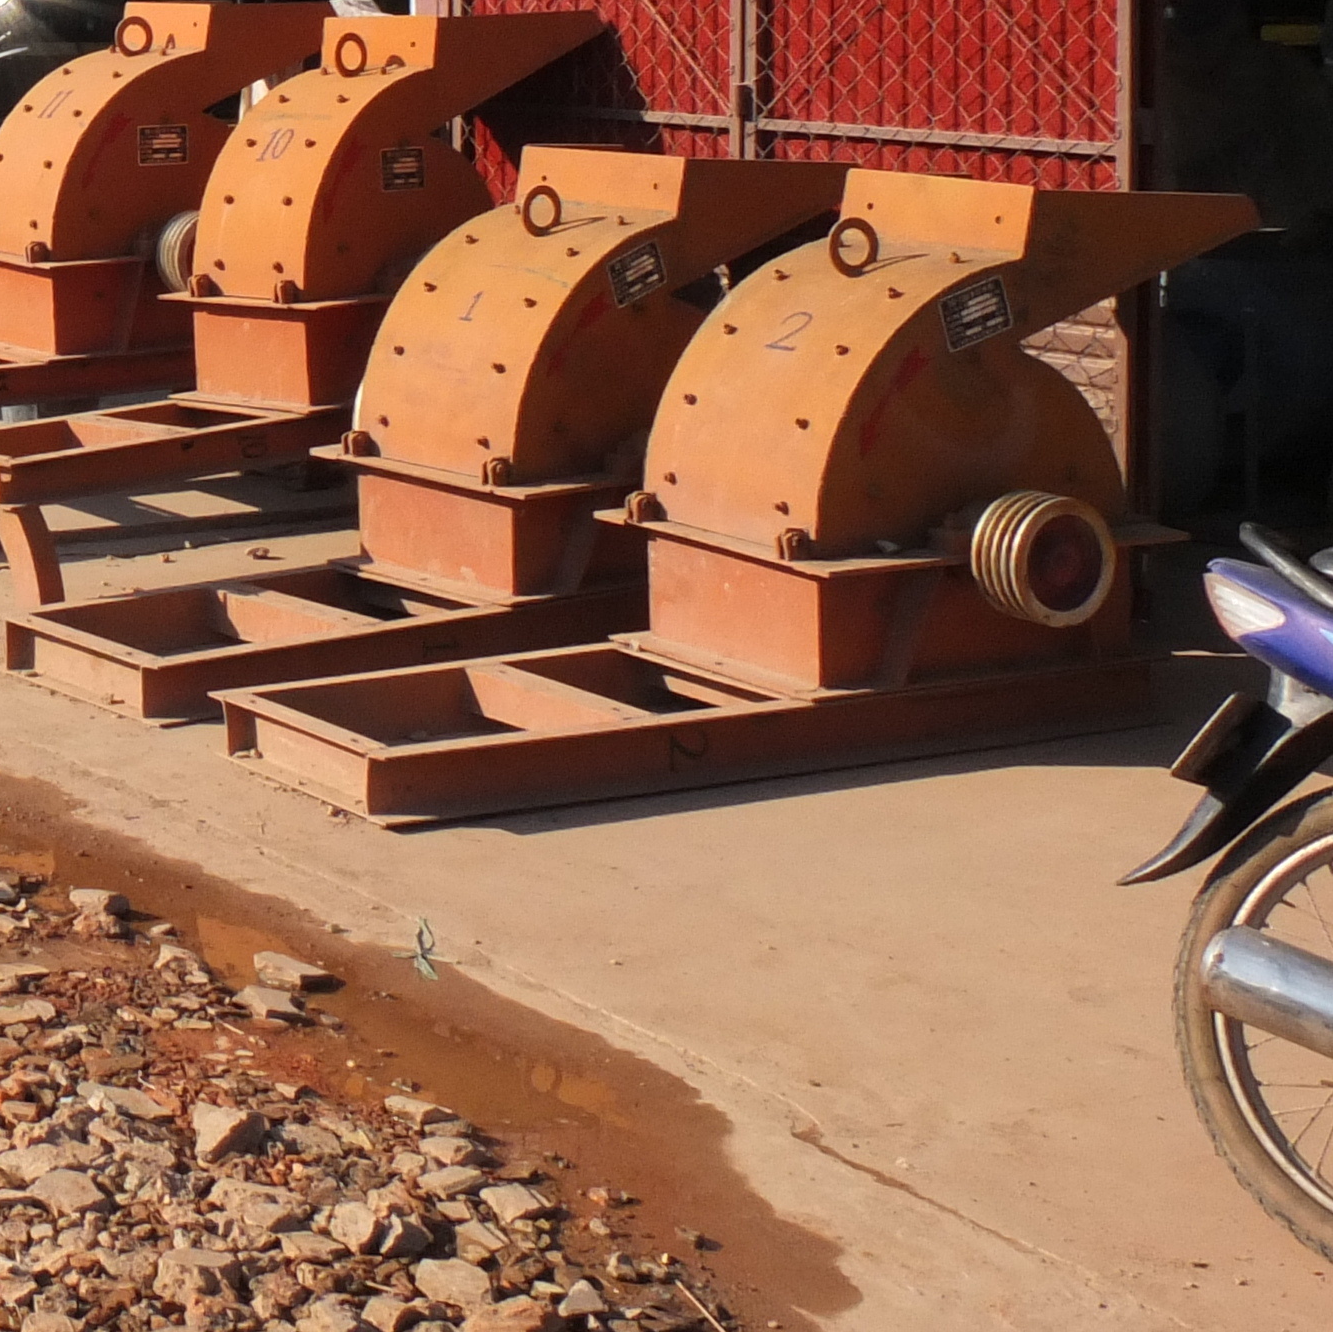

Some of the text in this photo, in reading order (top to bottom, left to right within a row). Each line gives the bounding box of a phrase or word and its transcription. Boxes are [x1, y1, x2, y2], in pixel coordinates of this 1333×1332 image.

[256, 128, 294, 161] 10
[458, 291, 484, 321] 1
[764, 311, 813, 351] 2
